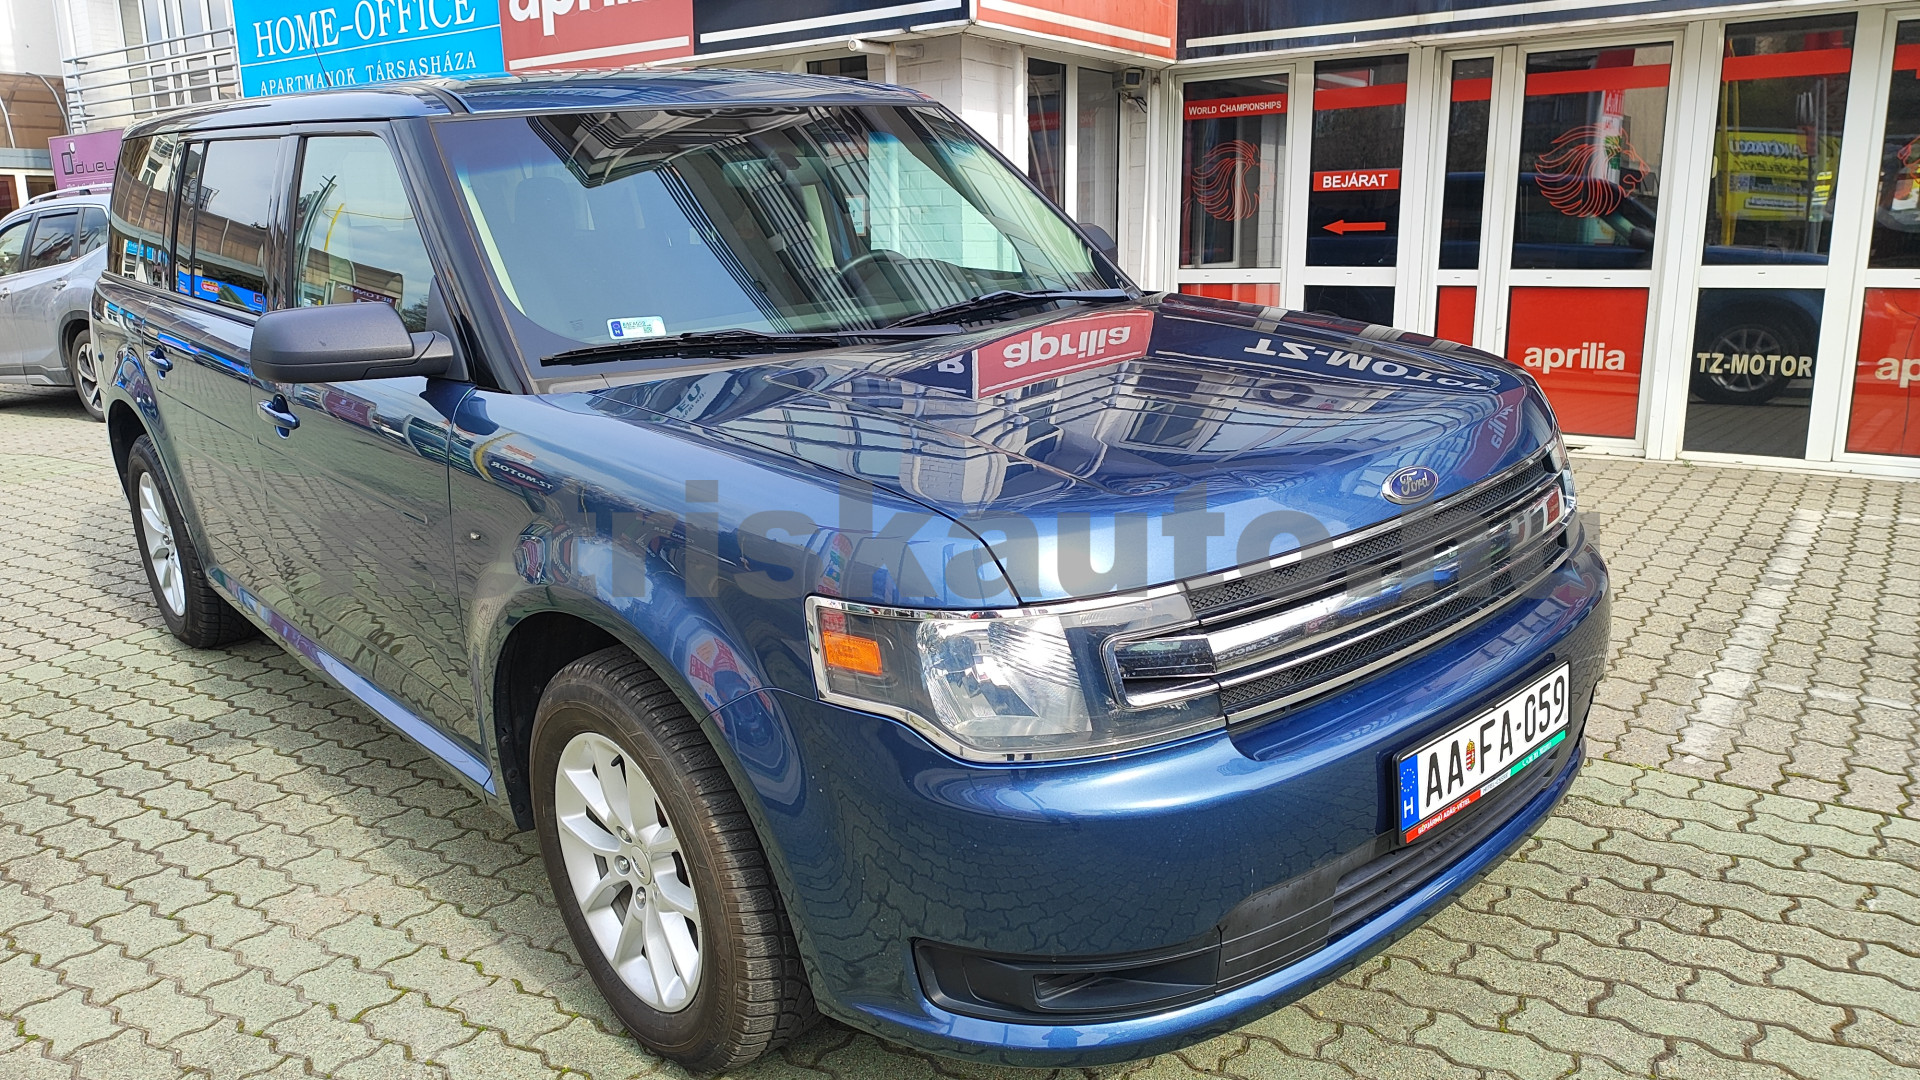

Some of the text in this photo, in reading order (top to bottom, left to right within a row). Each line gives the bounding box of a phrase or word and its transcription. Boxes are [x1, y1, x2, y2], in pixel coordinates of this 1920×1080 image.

[253, 0, 476, 58] HOME-OFFICE
[260, 51, 477, 97] APARTMANOK TÁRSASHÁZA
[1188, 100, 1282, 116] WORLD CHAMPIONSHIPS
[1322, 172, 1389, 189] BEJÁRAT
[1523, 341, 1626, 374] aprilia
[1696, 352, 1813, 378] TZ-MOTOR
[1400, 470, 1430, 496] Ford
[1403, 797, 1415, 819] H
[1426, 740, 1464, 808] AA
